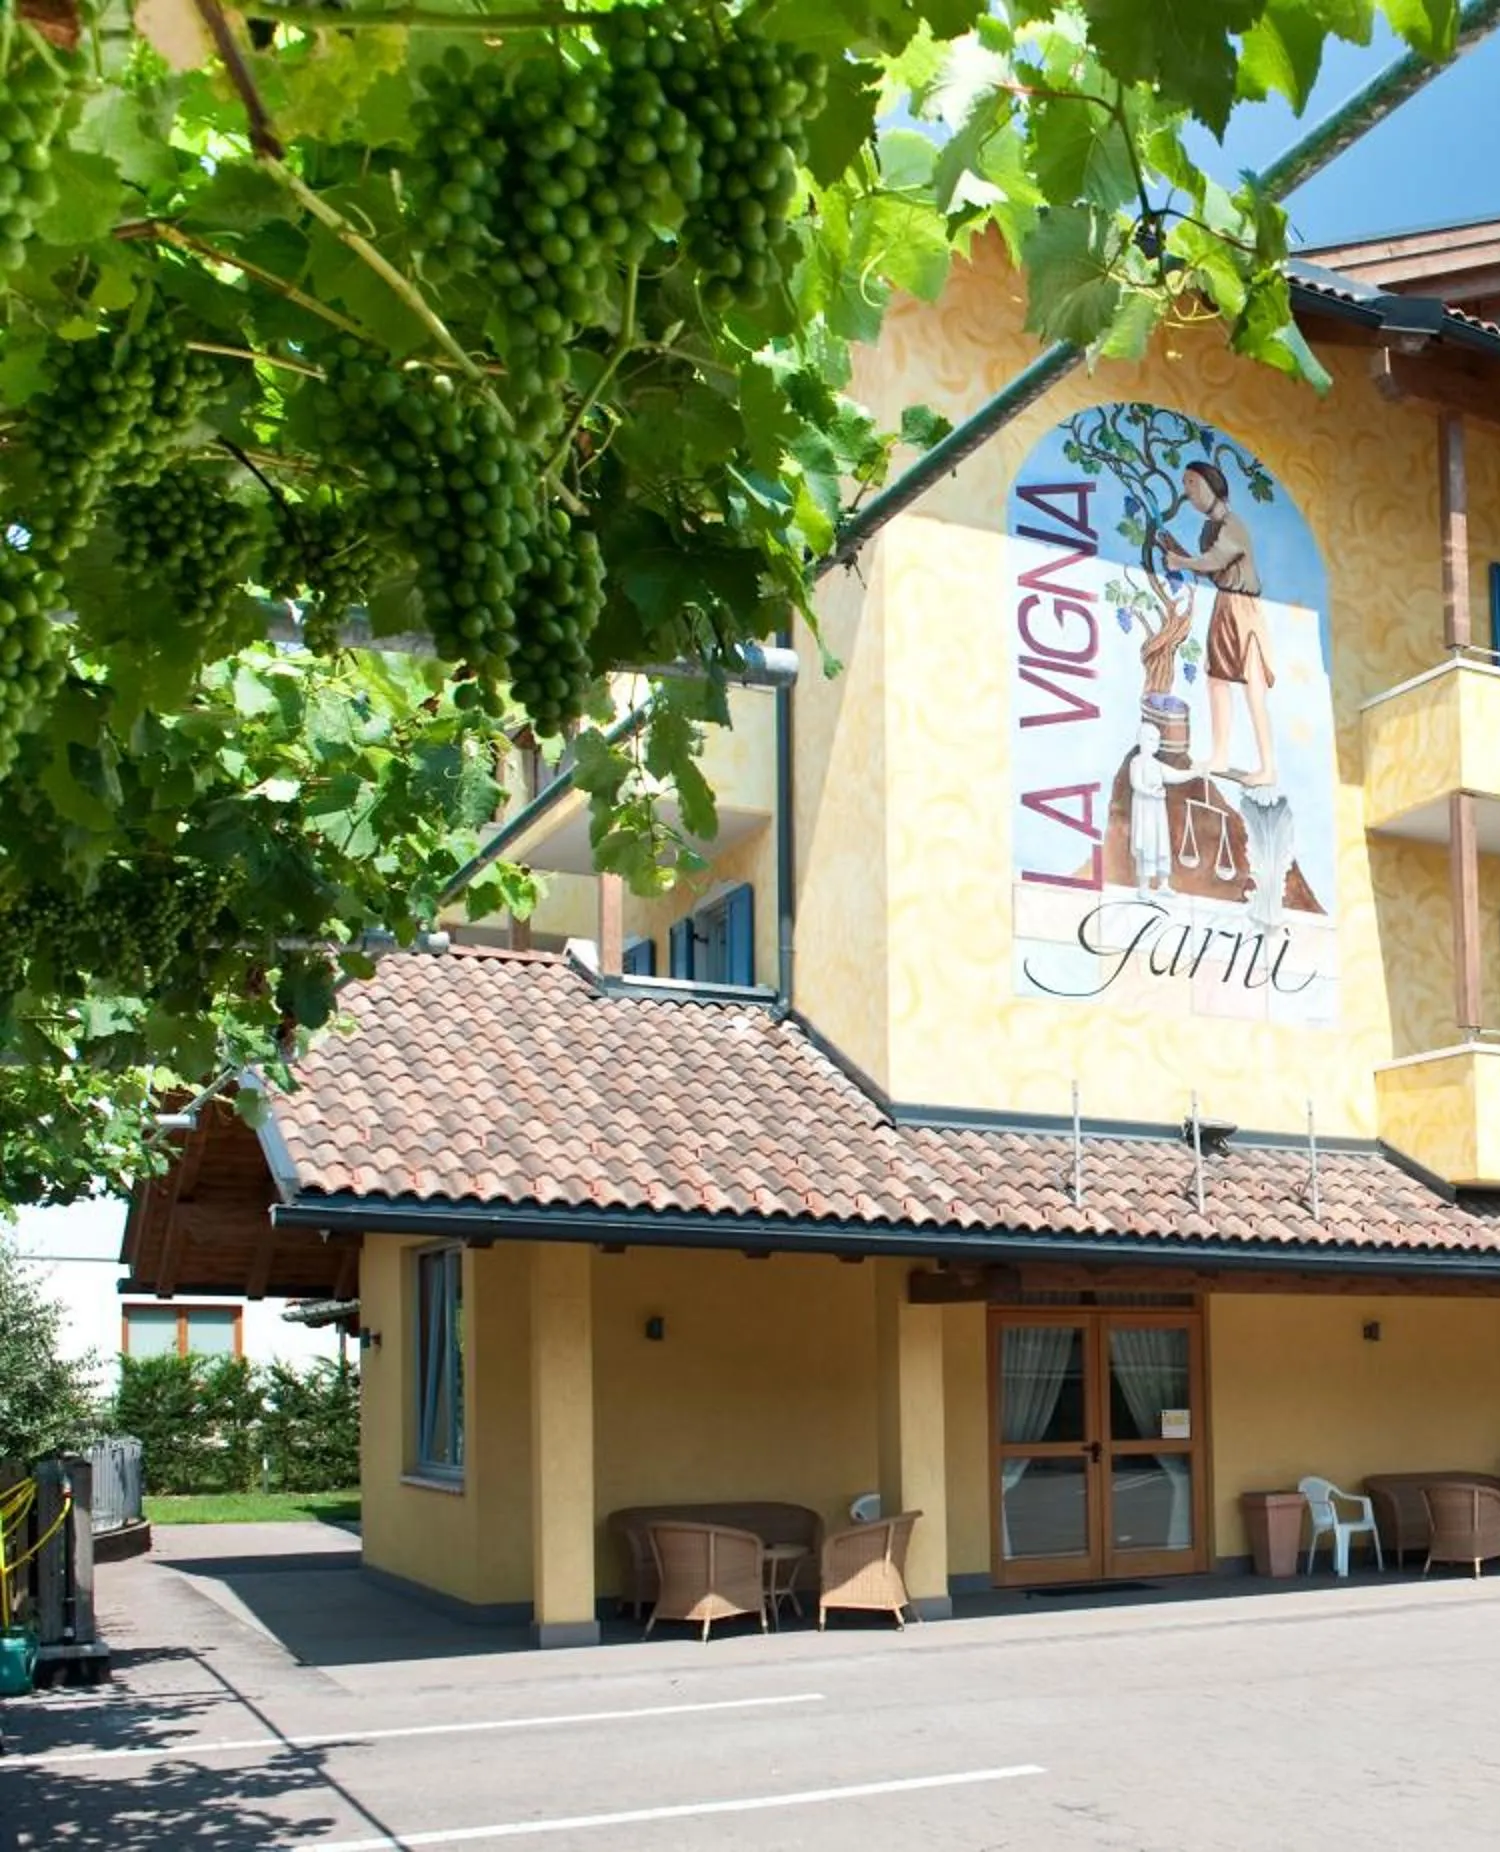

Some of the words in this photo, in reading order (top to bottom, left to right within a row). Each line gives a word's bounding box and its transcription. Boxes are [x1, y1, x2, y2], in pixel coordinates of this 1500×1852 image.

[1016, 481, 1102, 728] VIGNA
[1021, 782, 1104, 892] LA
[1023, 900, 1318, 998] Garni
